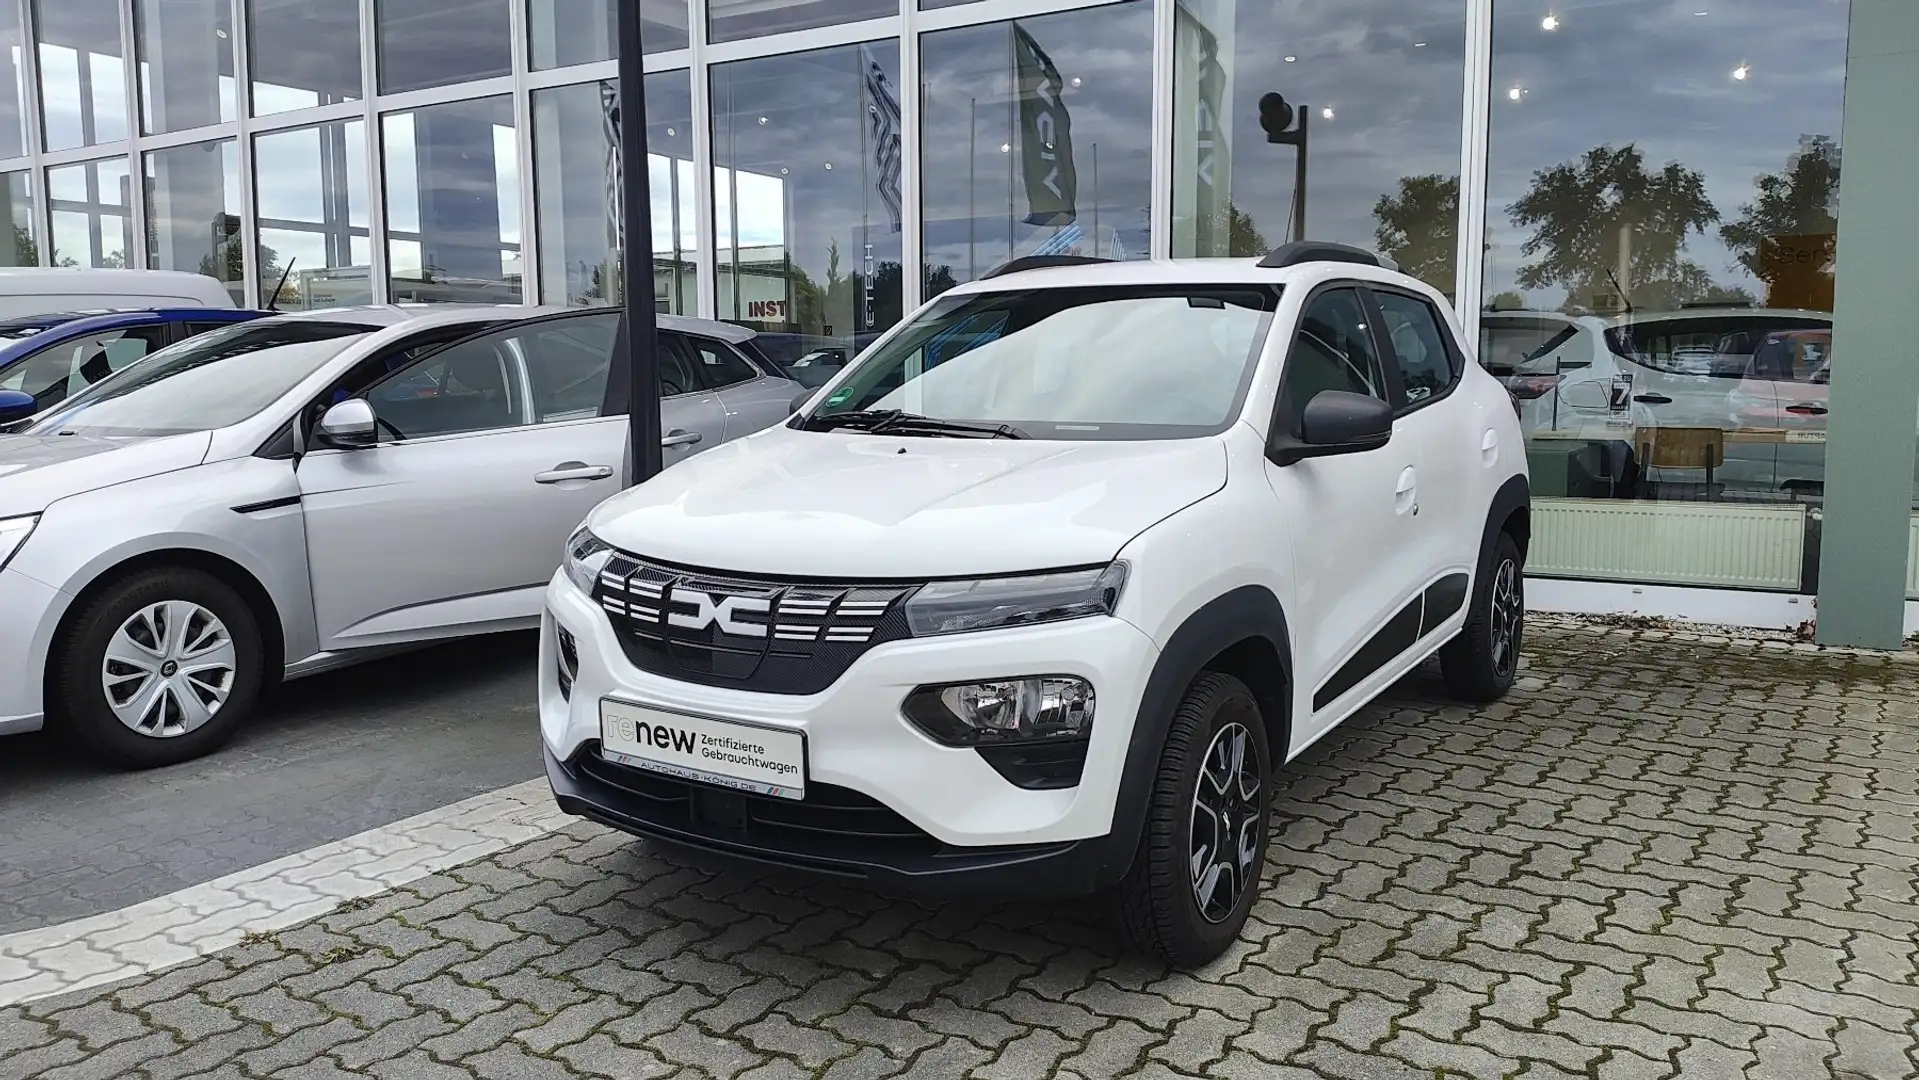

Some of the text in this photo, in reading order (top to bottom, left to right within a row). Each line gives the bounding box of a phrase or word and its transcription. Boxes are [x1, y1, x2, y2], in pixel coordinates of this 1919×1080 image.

[749, 300, 786, 318] INST
[1613, 382, 1631, 404] 7
[607, 715, 696, 754] renew
[701, 734, 765, 755] Zertifizierte
[701, 747, 798, 774] Gebrauchtwagen
